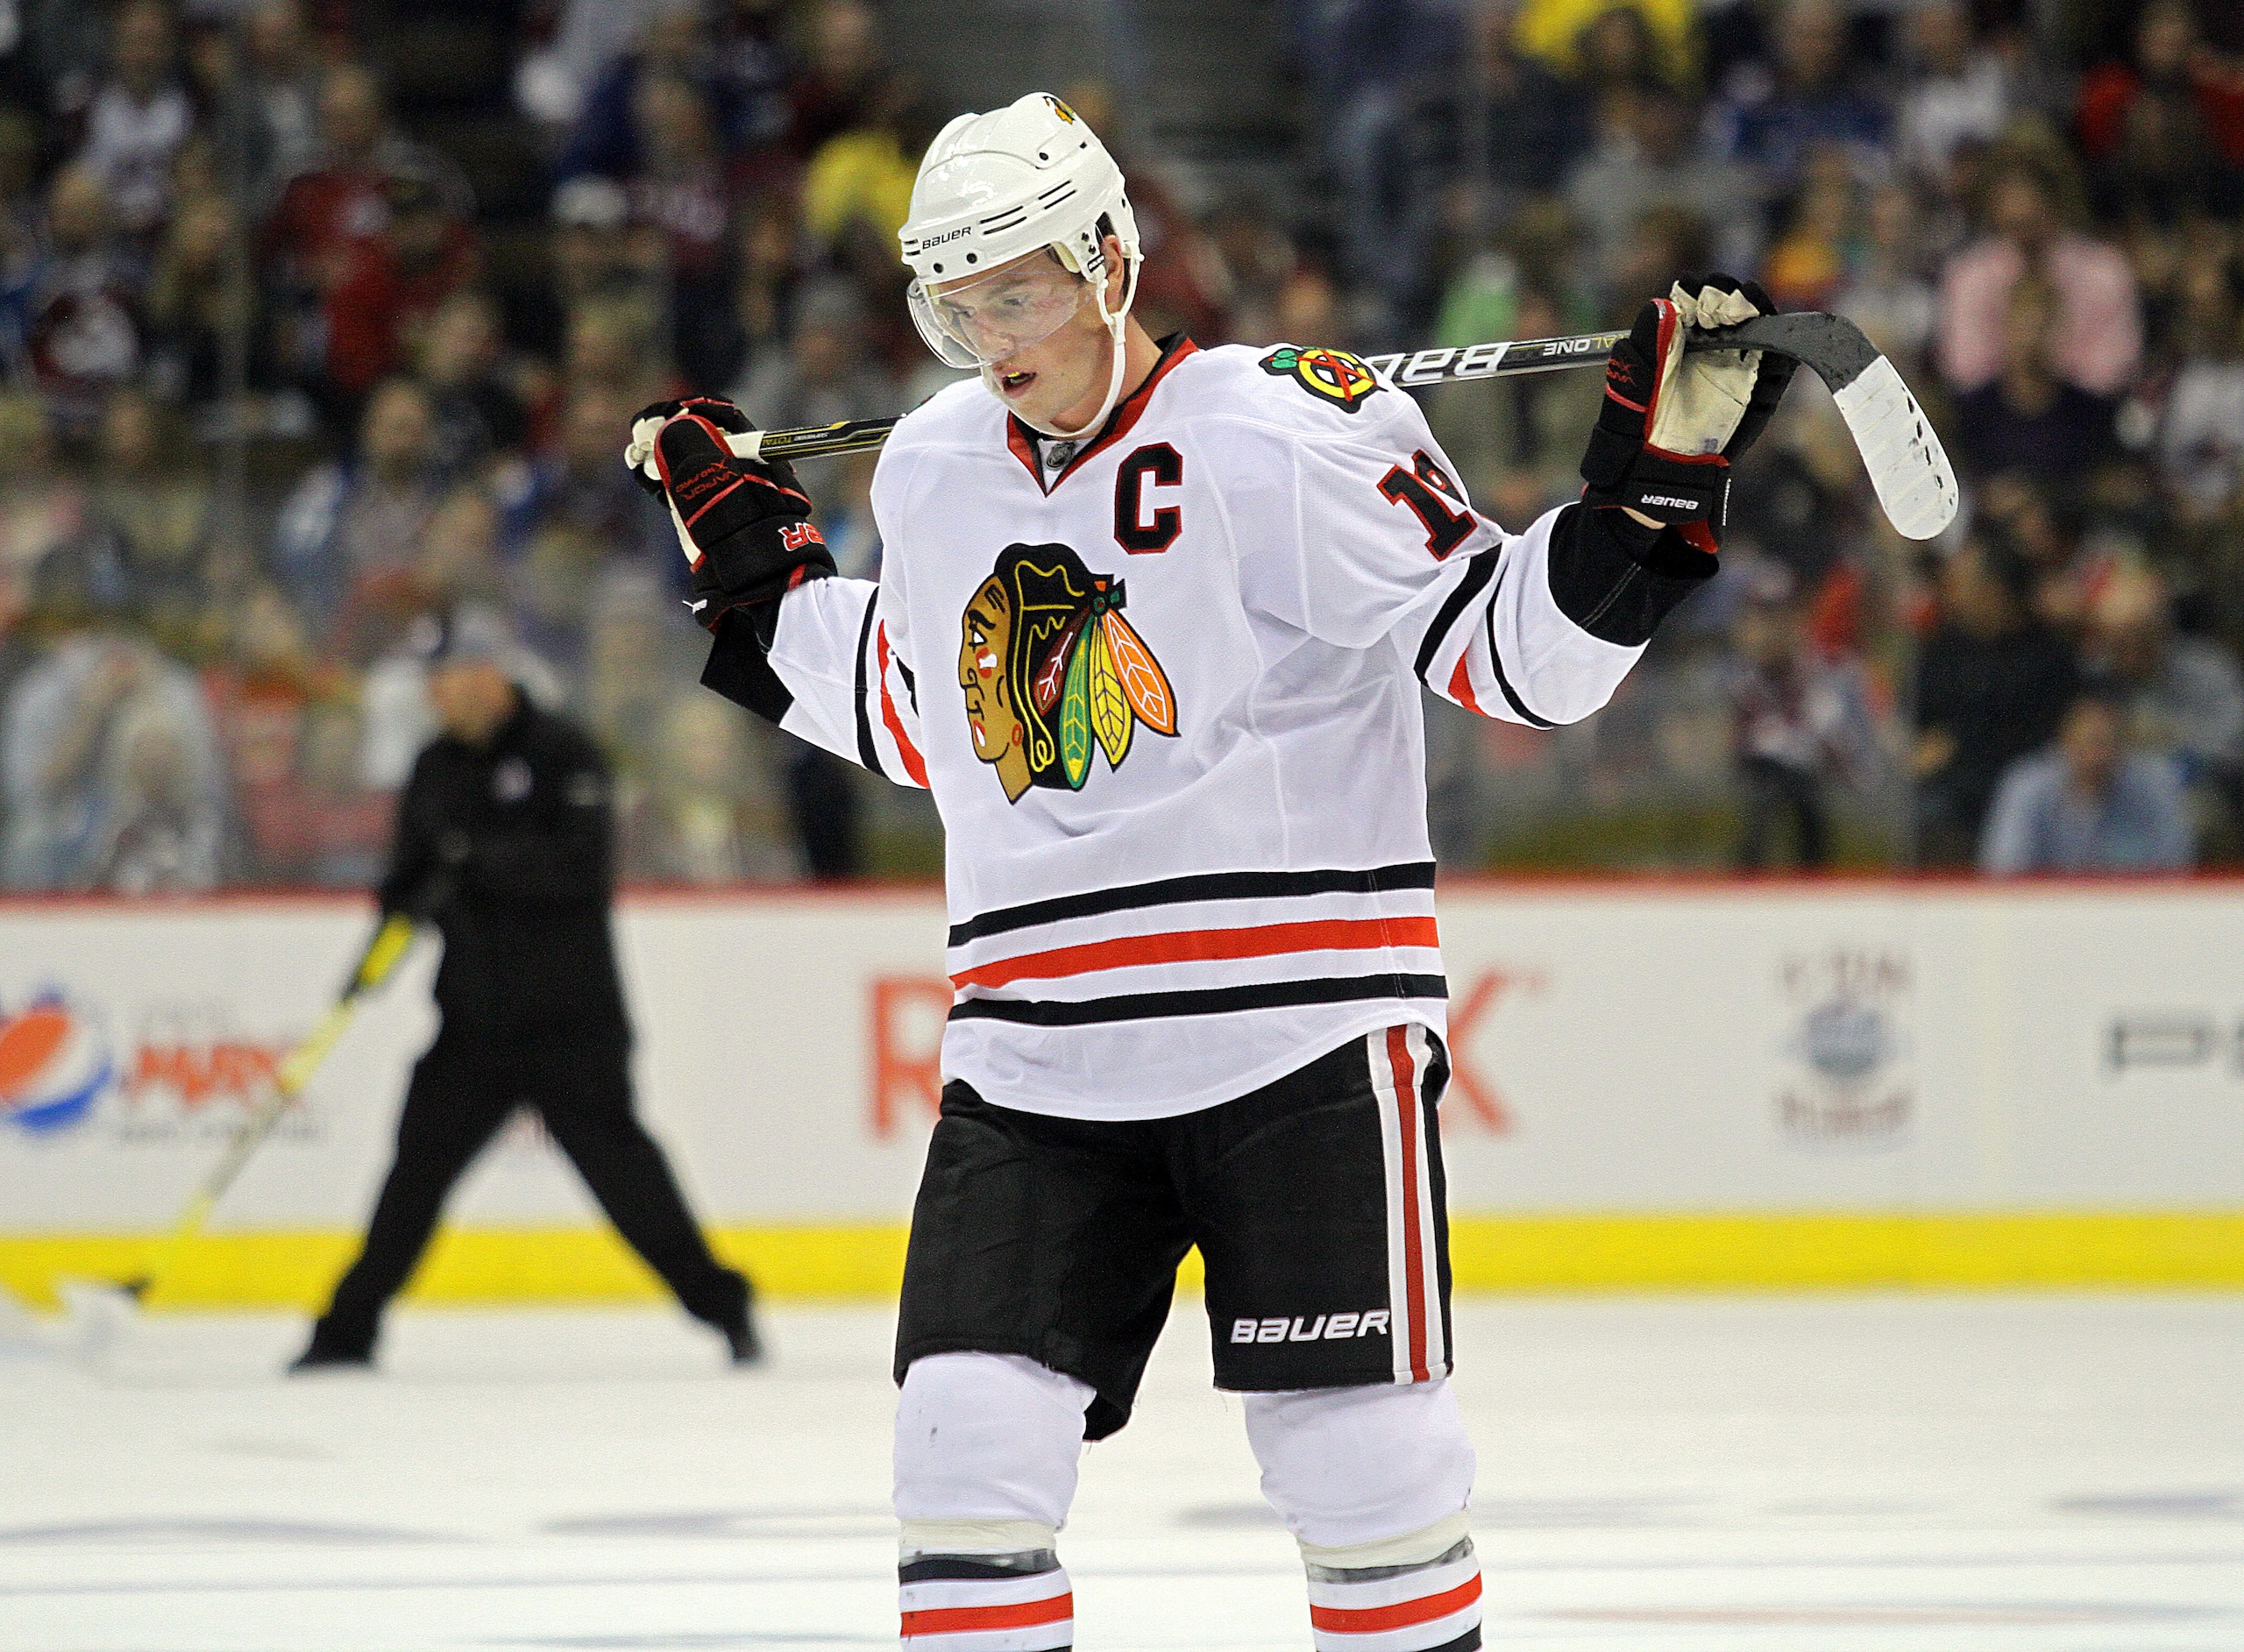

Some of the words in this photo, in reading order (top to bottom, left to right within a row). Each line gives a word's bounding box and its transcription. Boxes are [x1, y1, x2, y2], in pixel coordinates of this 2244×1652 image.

[921, 226, 972, 251] BAUER
[1114, 442, 1182, 555] C
[1640, 493, 1699, 511] BAUER
[1230, 1308, 1391, 1344] BAUER
